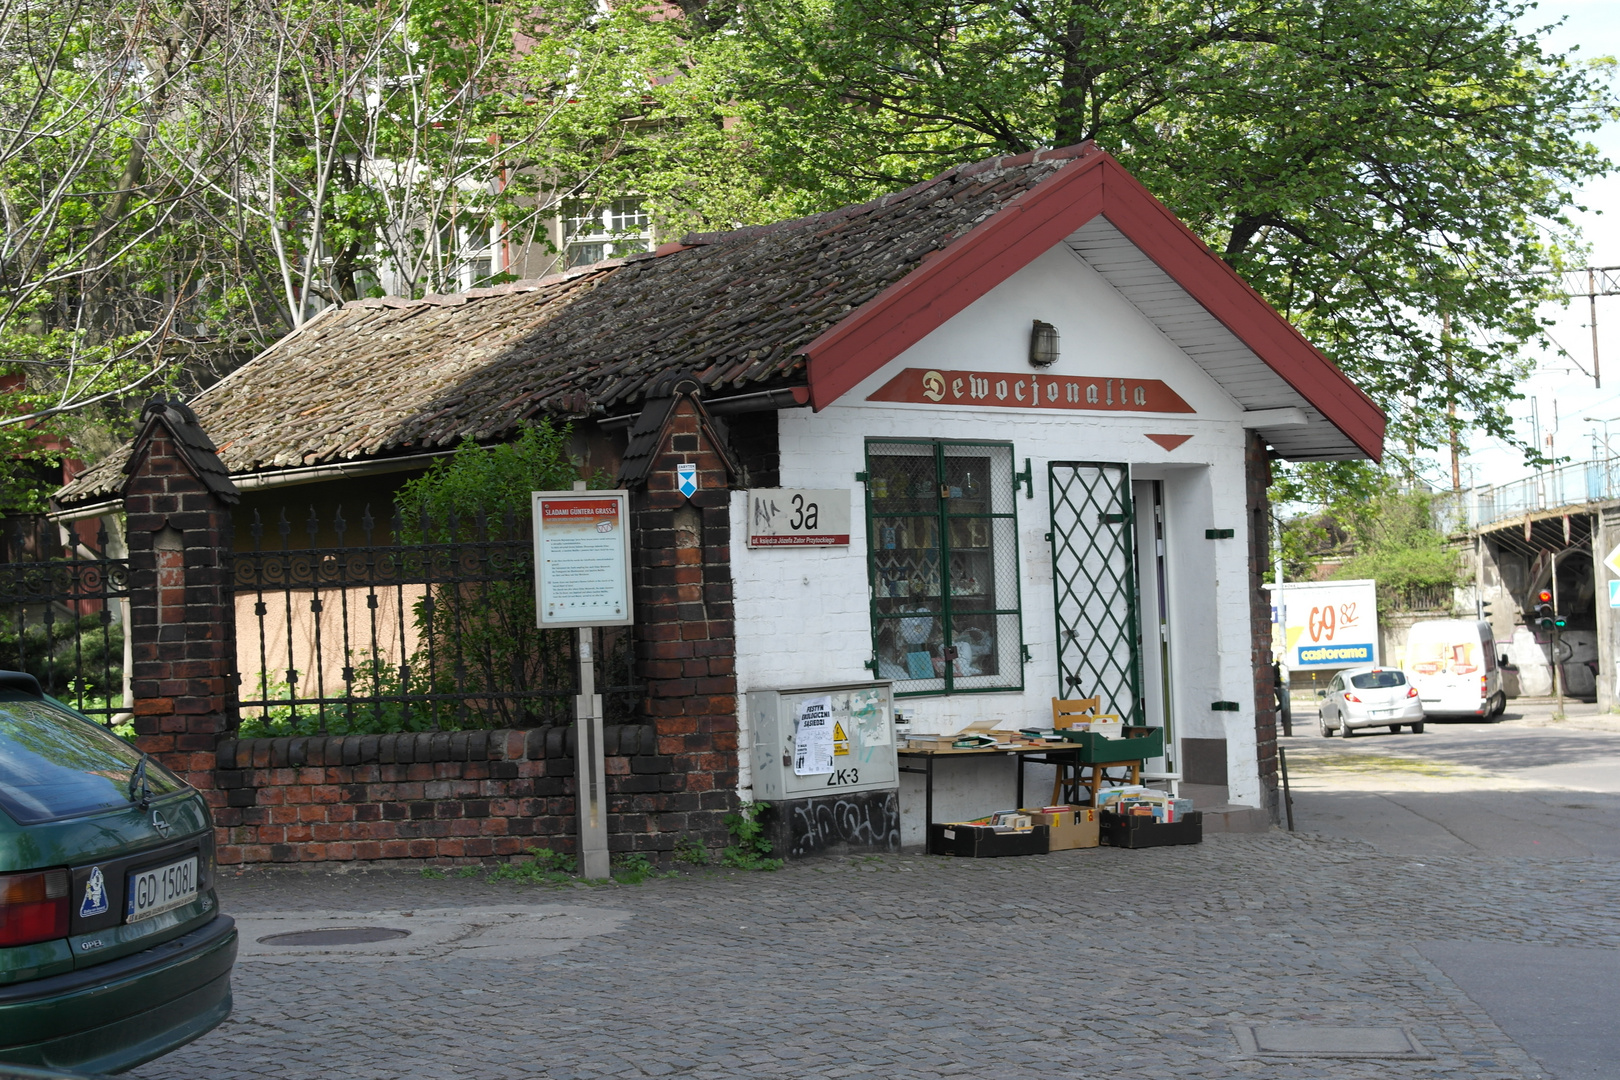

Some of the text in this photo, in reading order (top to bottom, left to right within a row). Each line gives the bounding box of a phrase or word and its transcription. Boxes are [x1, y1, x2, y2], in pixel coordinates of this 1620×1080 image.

[922, 370, 1147, 407] Dewocjonalia
[595, 507, 616, 515] GRASSA
[790, 493, 818, 531] 3a
[1309, 602, 1359, 643] 69 82
[1301, 647, 1368, 661] castorama
[827, 768, 859, 786] ZK-3
[137, 874, 156, 909] GD
[162, 861, 194, 902] 1508L
[81, 940, 104, 950] OPEL
